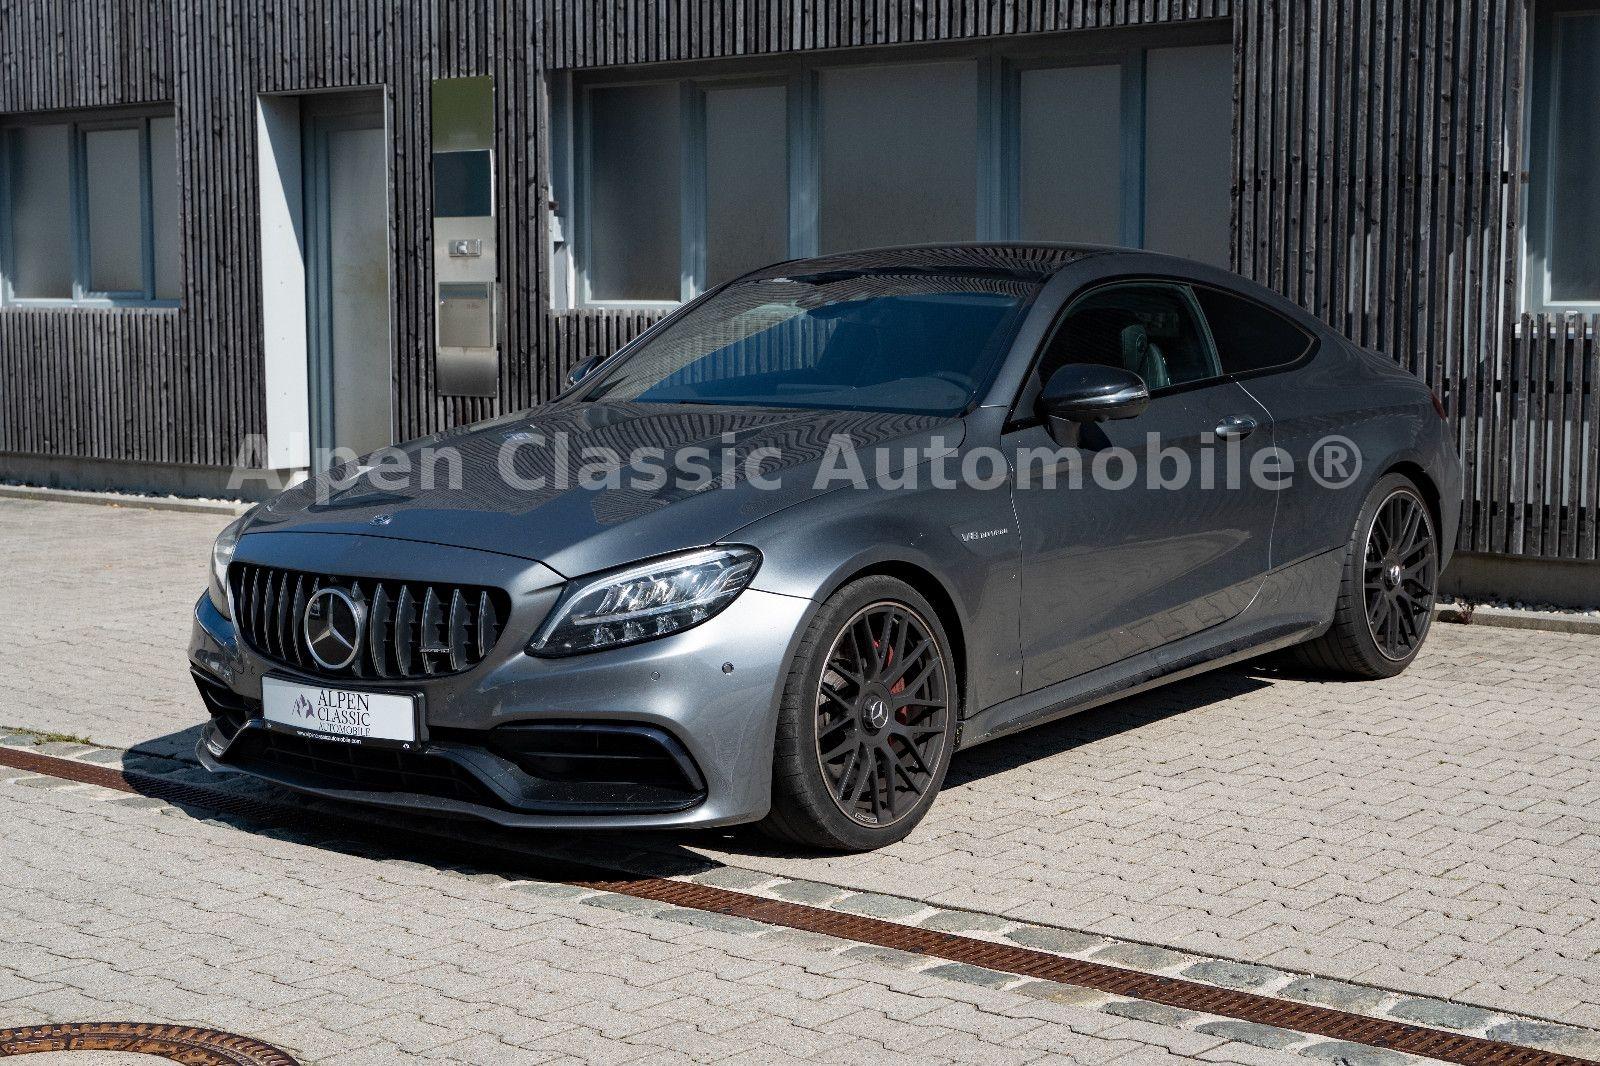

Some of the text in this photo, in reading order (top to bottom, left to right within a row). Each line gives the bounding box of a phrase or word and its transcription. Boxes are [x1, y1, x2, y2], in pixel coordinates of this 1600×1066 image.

[961, 531, 978, 542] V8
[317, 689, 370, 712] ALPEN
[317, 707, 371, 727] CLASSIC
[318, 722, 371, 737] AUTOMOBILE
